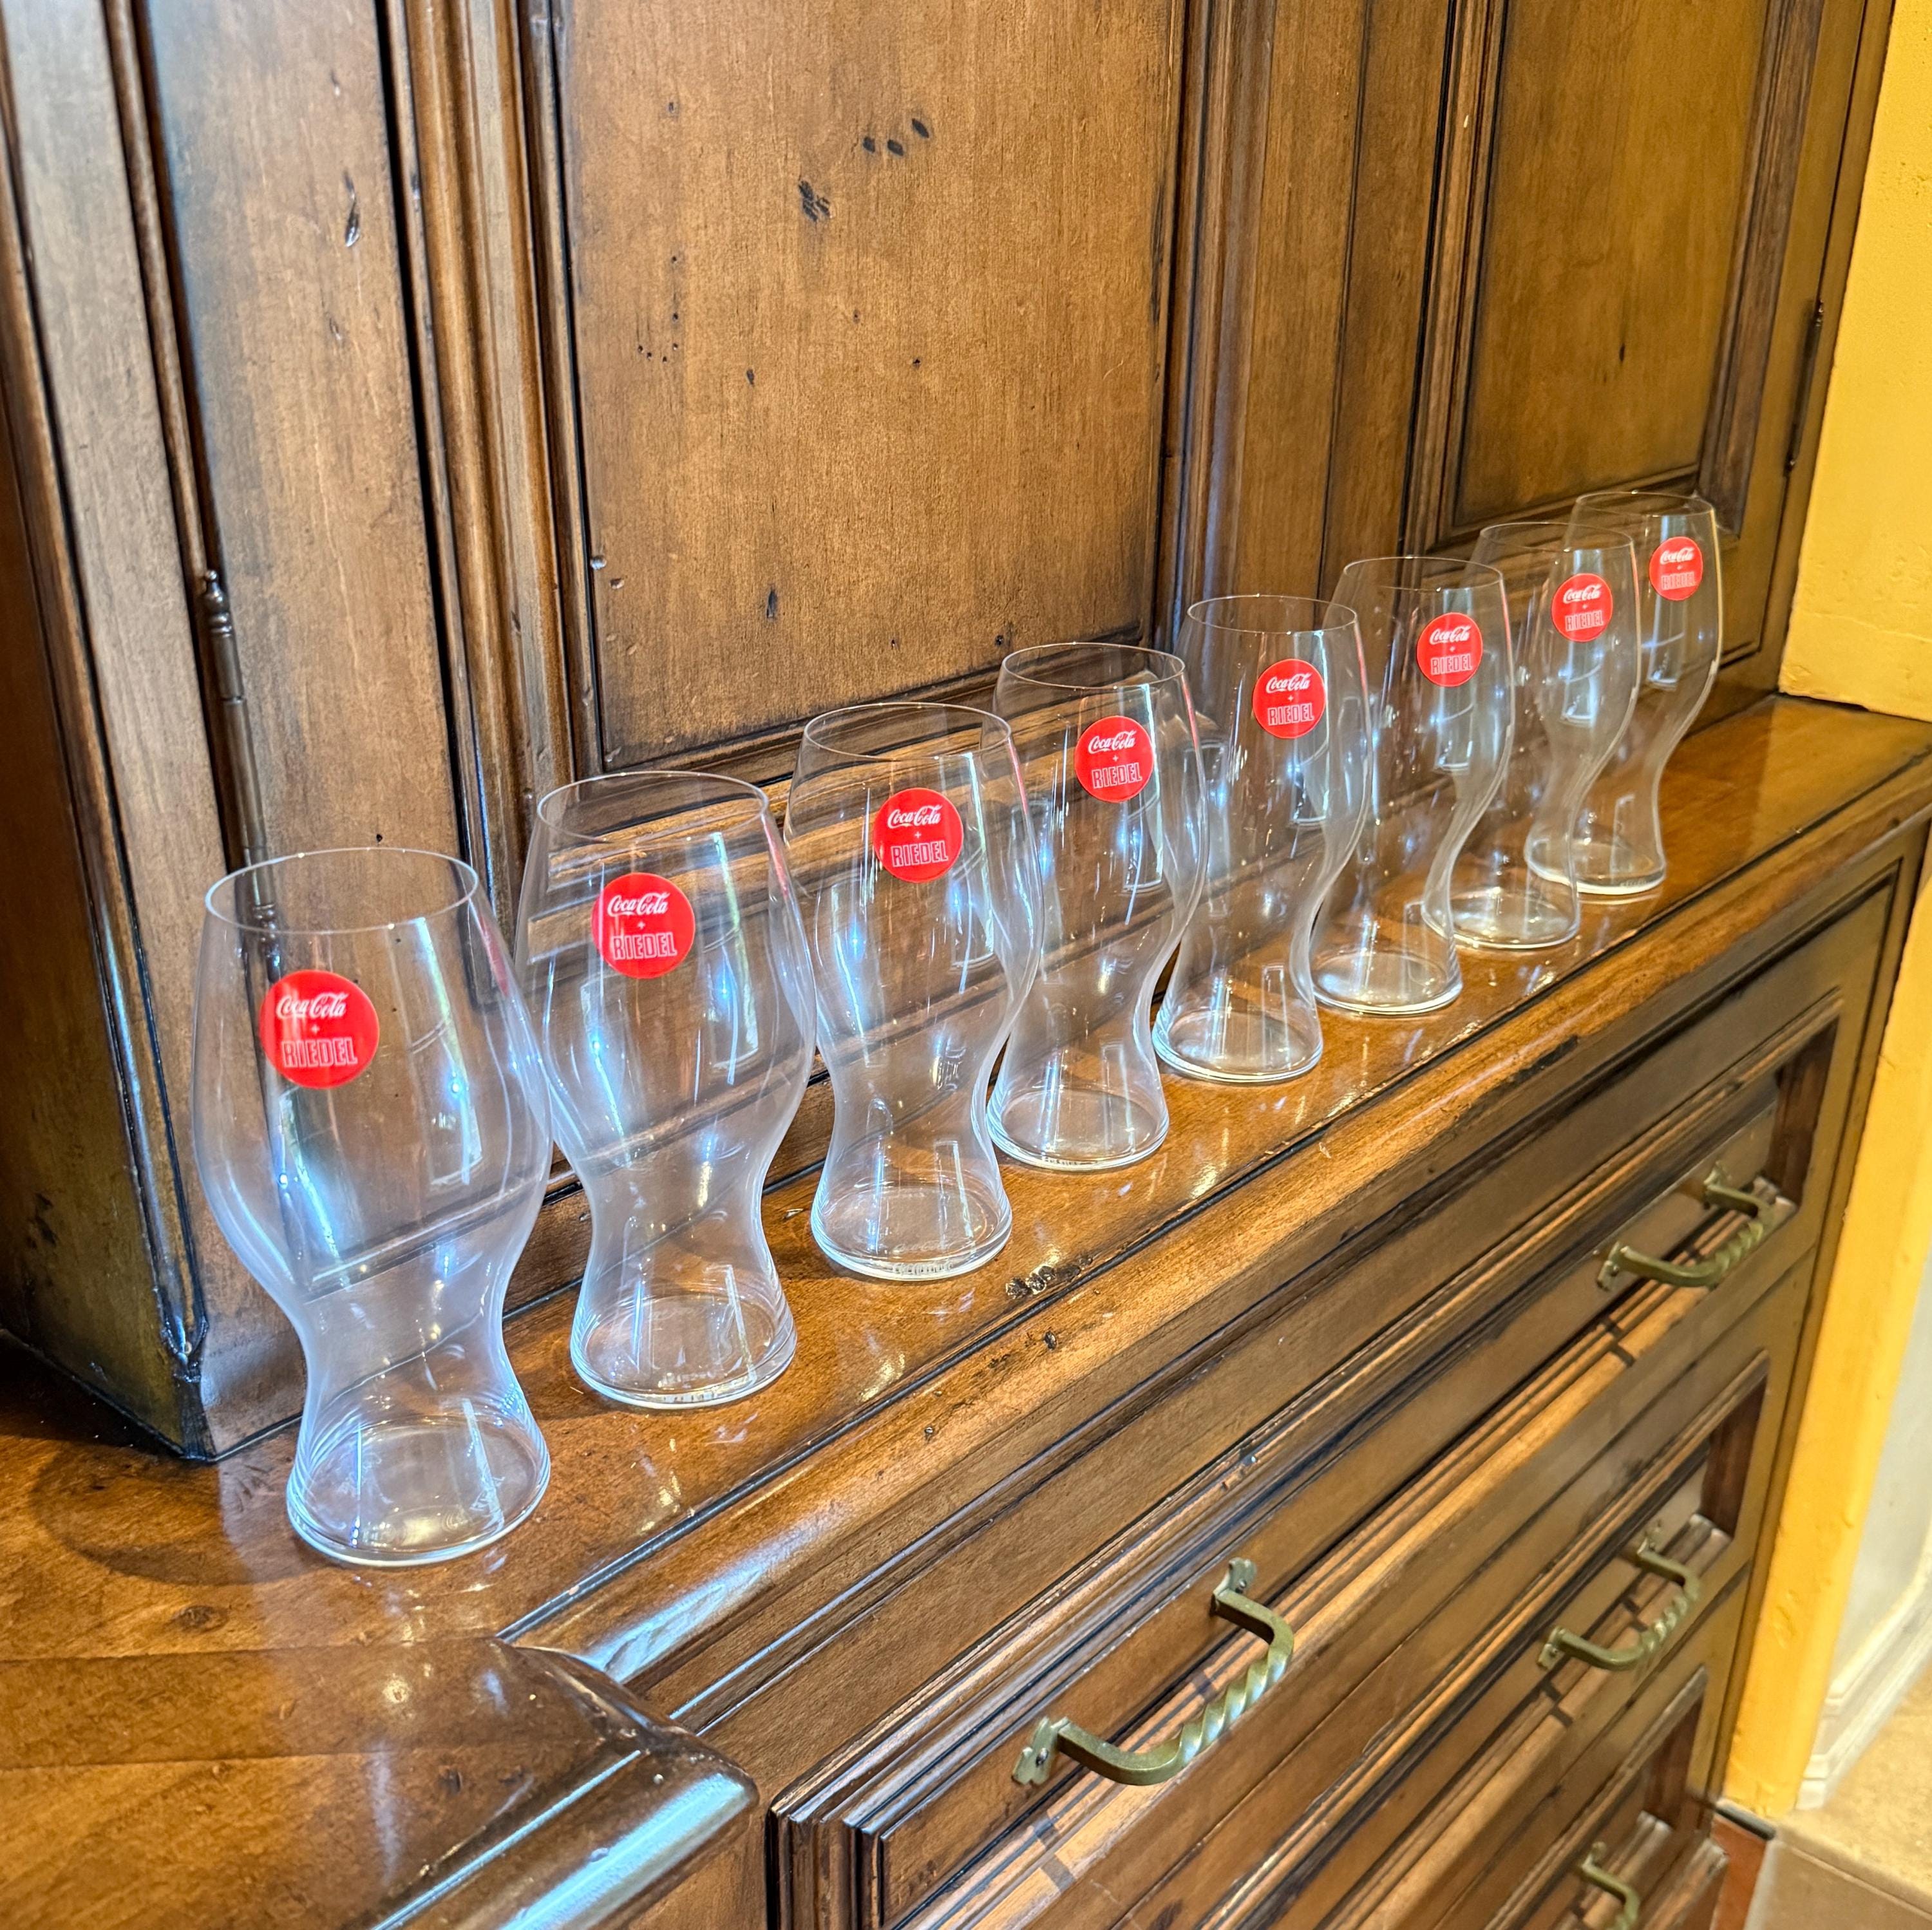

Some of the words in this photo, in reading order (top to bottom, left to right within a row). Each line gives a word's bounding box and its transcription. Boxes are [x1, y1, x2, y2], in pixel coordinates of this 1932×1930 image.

[1431, 654, 1473, 675] RIEDEL
[1266, 673, 1312, 694] Coca-Cola
[1268, 703, 1314, 726] RIEDEL
[1088, 730, 1137, 754] Coca-Cola
[1092, 762, 1142, 789] RIEDEL
[887, 805, 943, 828] Coca-Cola
[891, 840, 948, 867] RIEDEL
[607, 893, 670, 916] Coca-Cola
[613, 932, 677, 960] RIEDEL
[276, 992, 350, 1019] Coca-Cola
[281, 1037, 357, 1068] RIEDEL
